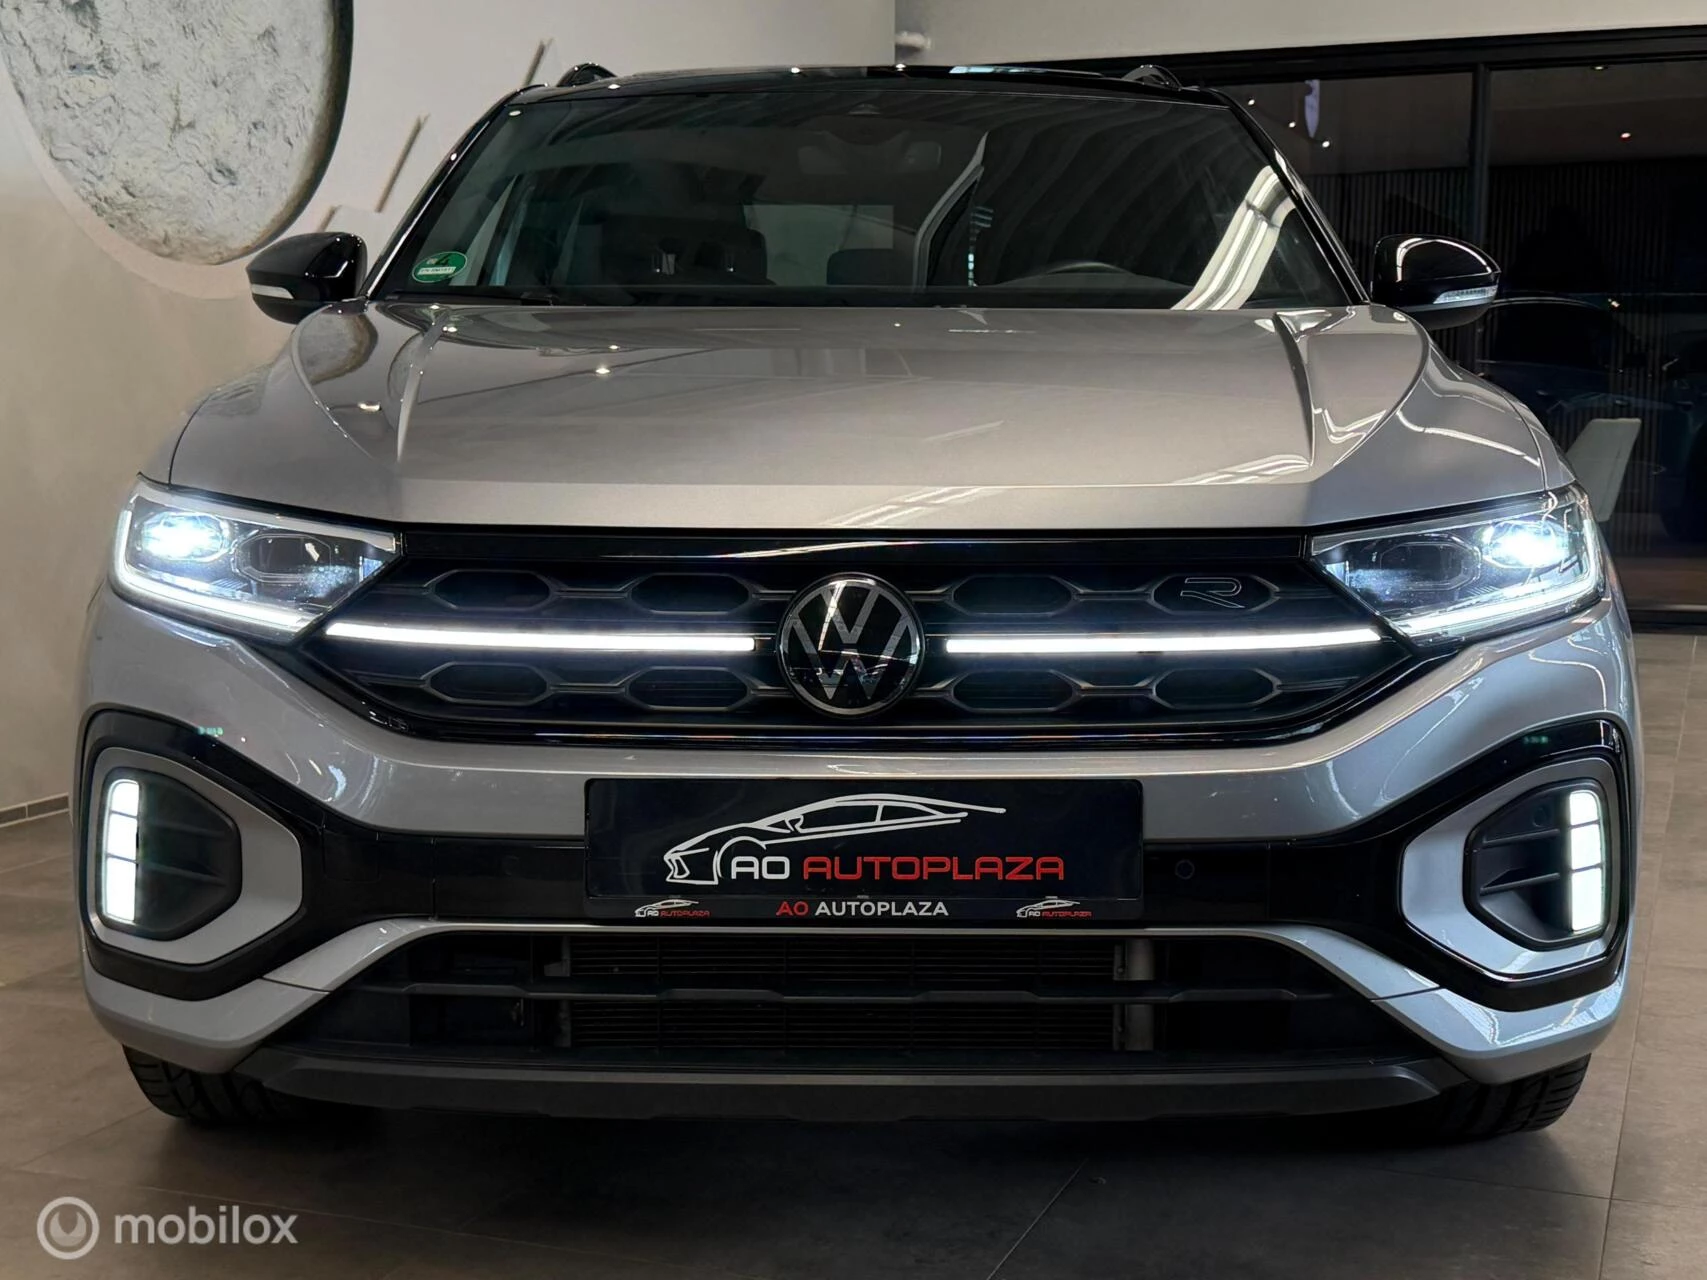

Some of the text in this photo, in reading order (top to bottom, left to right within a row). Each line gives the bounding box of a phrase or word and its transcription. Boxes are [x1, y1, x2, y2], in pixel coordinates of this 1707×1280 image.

[731, 855, 1064, 881] AO AUTOPLAZA
[776, 901, 949, 916] AO AUTOPLAZA
